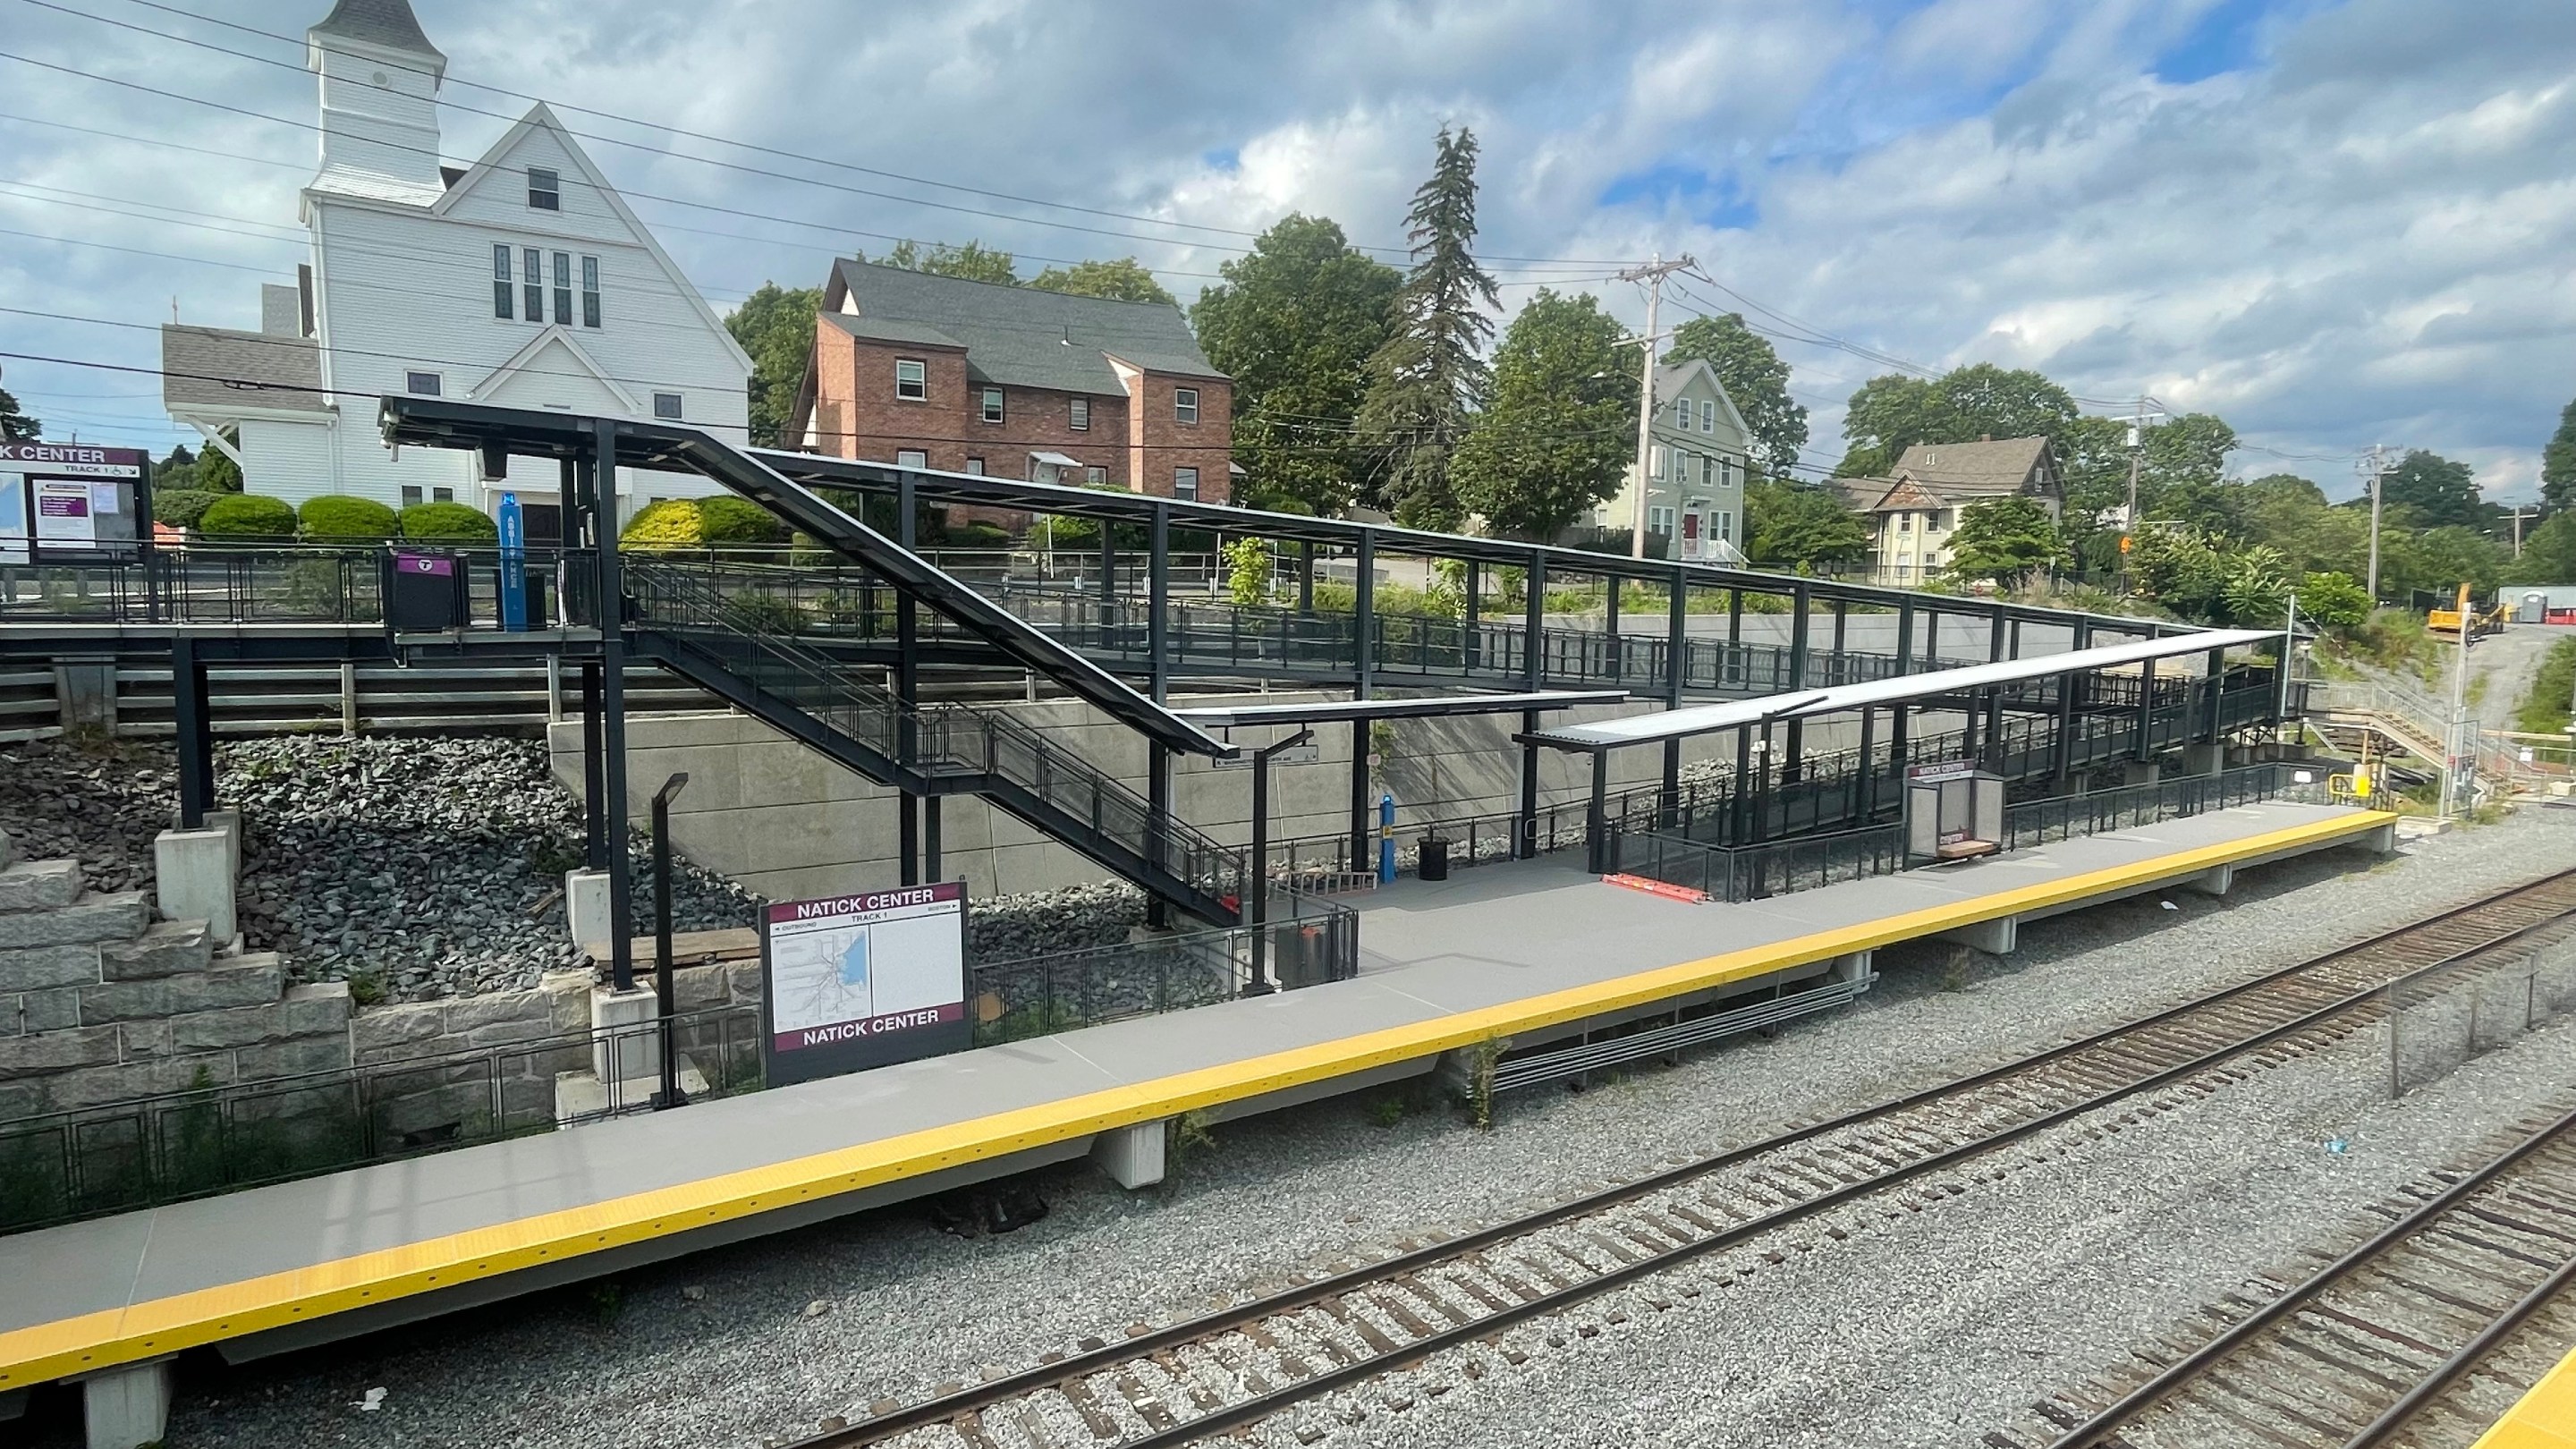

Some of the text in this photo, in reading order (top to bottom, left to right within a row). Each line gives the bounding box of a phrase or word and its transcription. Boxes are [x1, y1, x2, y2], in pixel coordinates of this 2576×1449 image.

[21, 446, 105, 462] CENTER
[797, 889, 934, 919] NATICK CENTER
[782, 922, 817, 930] OUTBOUND
[852, 914, 881, 923] TRACK
[803, 1009, 939, 1046] NATICK CENTER
